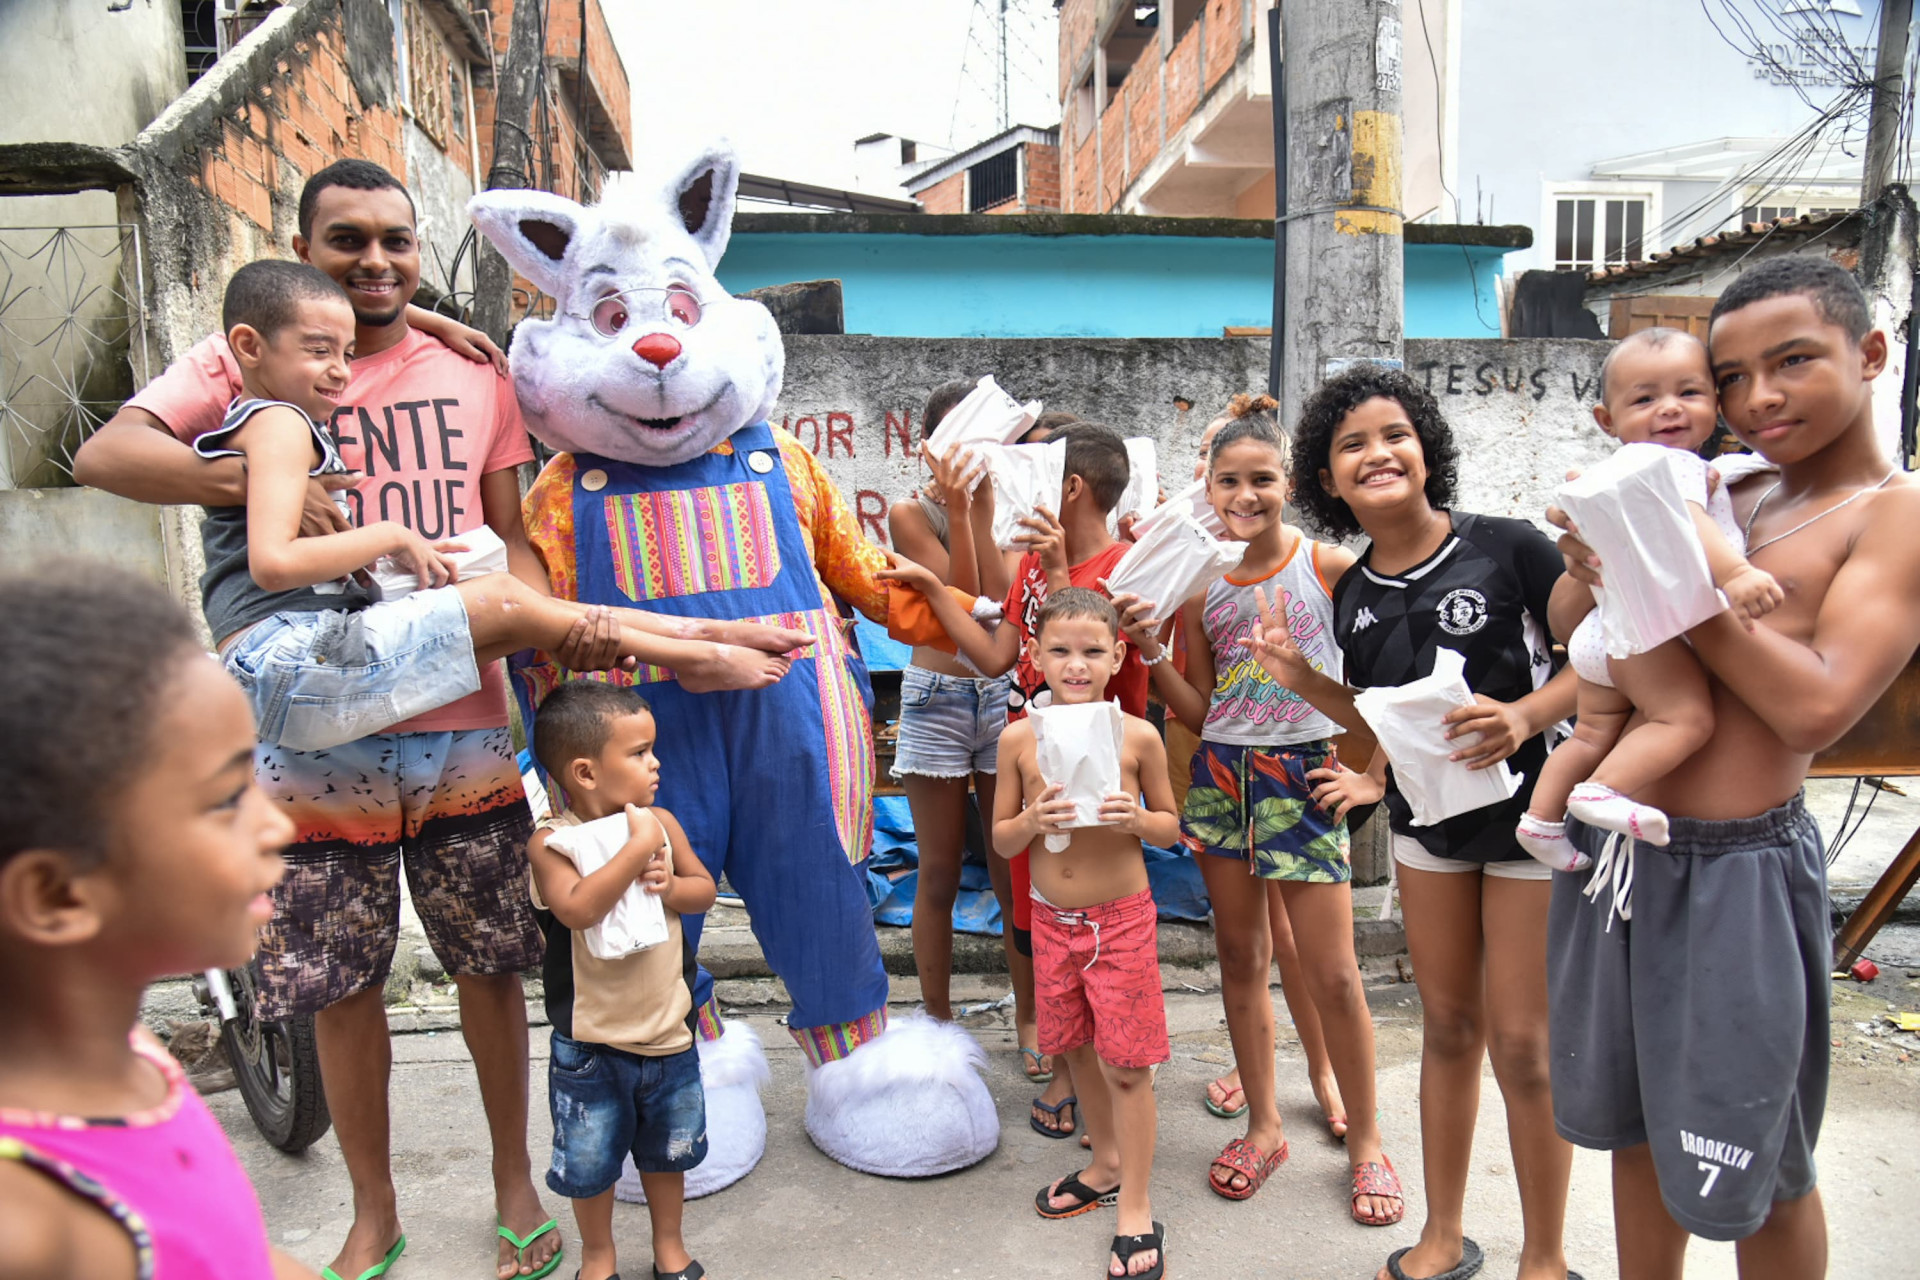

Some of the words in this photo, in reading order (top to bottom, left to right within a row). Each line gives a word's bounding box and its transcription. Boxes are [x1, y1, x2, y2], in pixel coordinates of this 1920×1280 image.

[1748, 42, 1878, 67] ADVENTIST
[330, 399, 467, 476] ENTE
[782, 411, 854, 460] OR
[1680, 1129, 1754, 1171] BROOKLYN
[1697, 1160, 1721, 1198] 7
